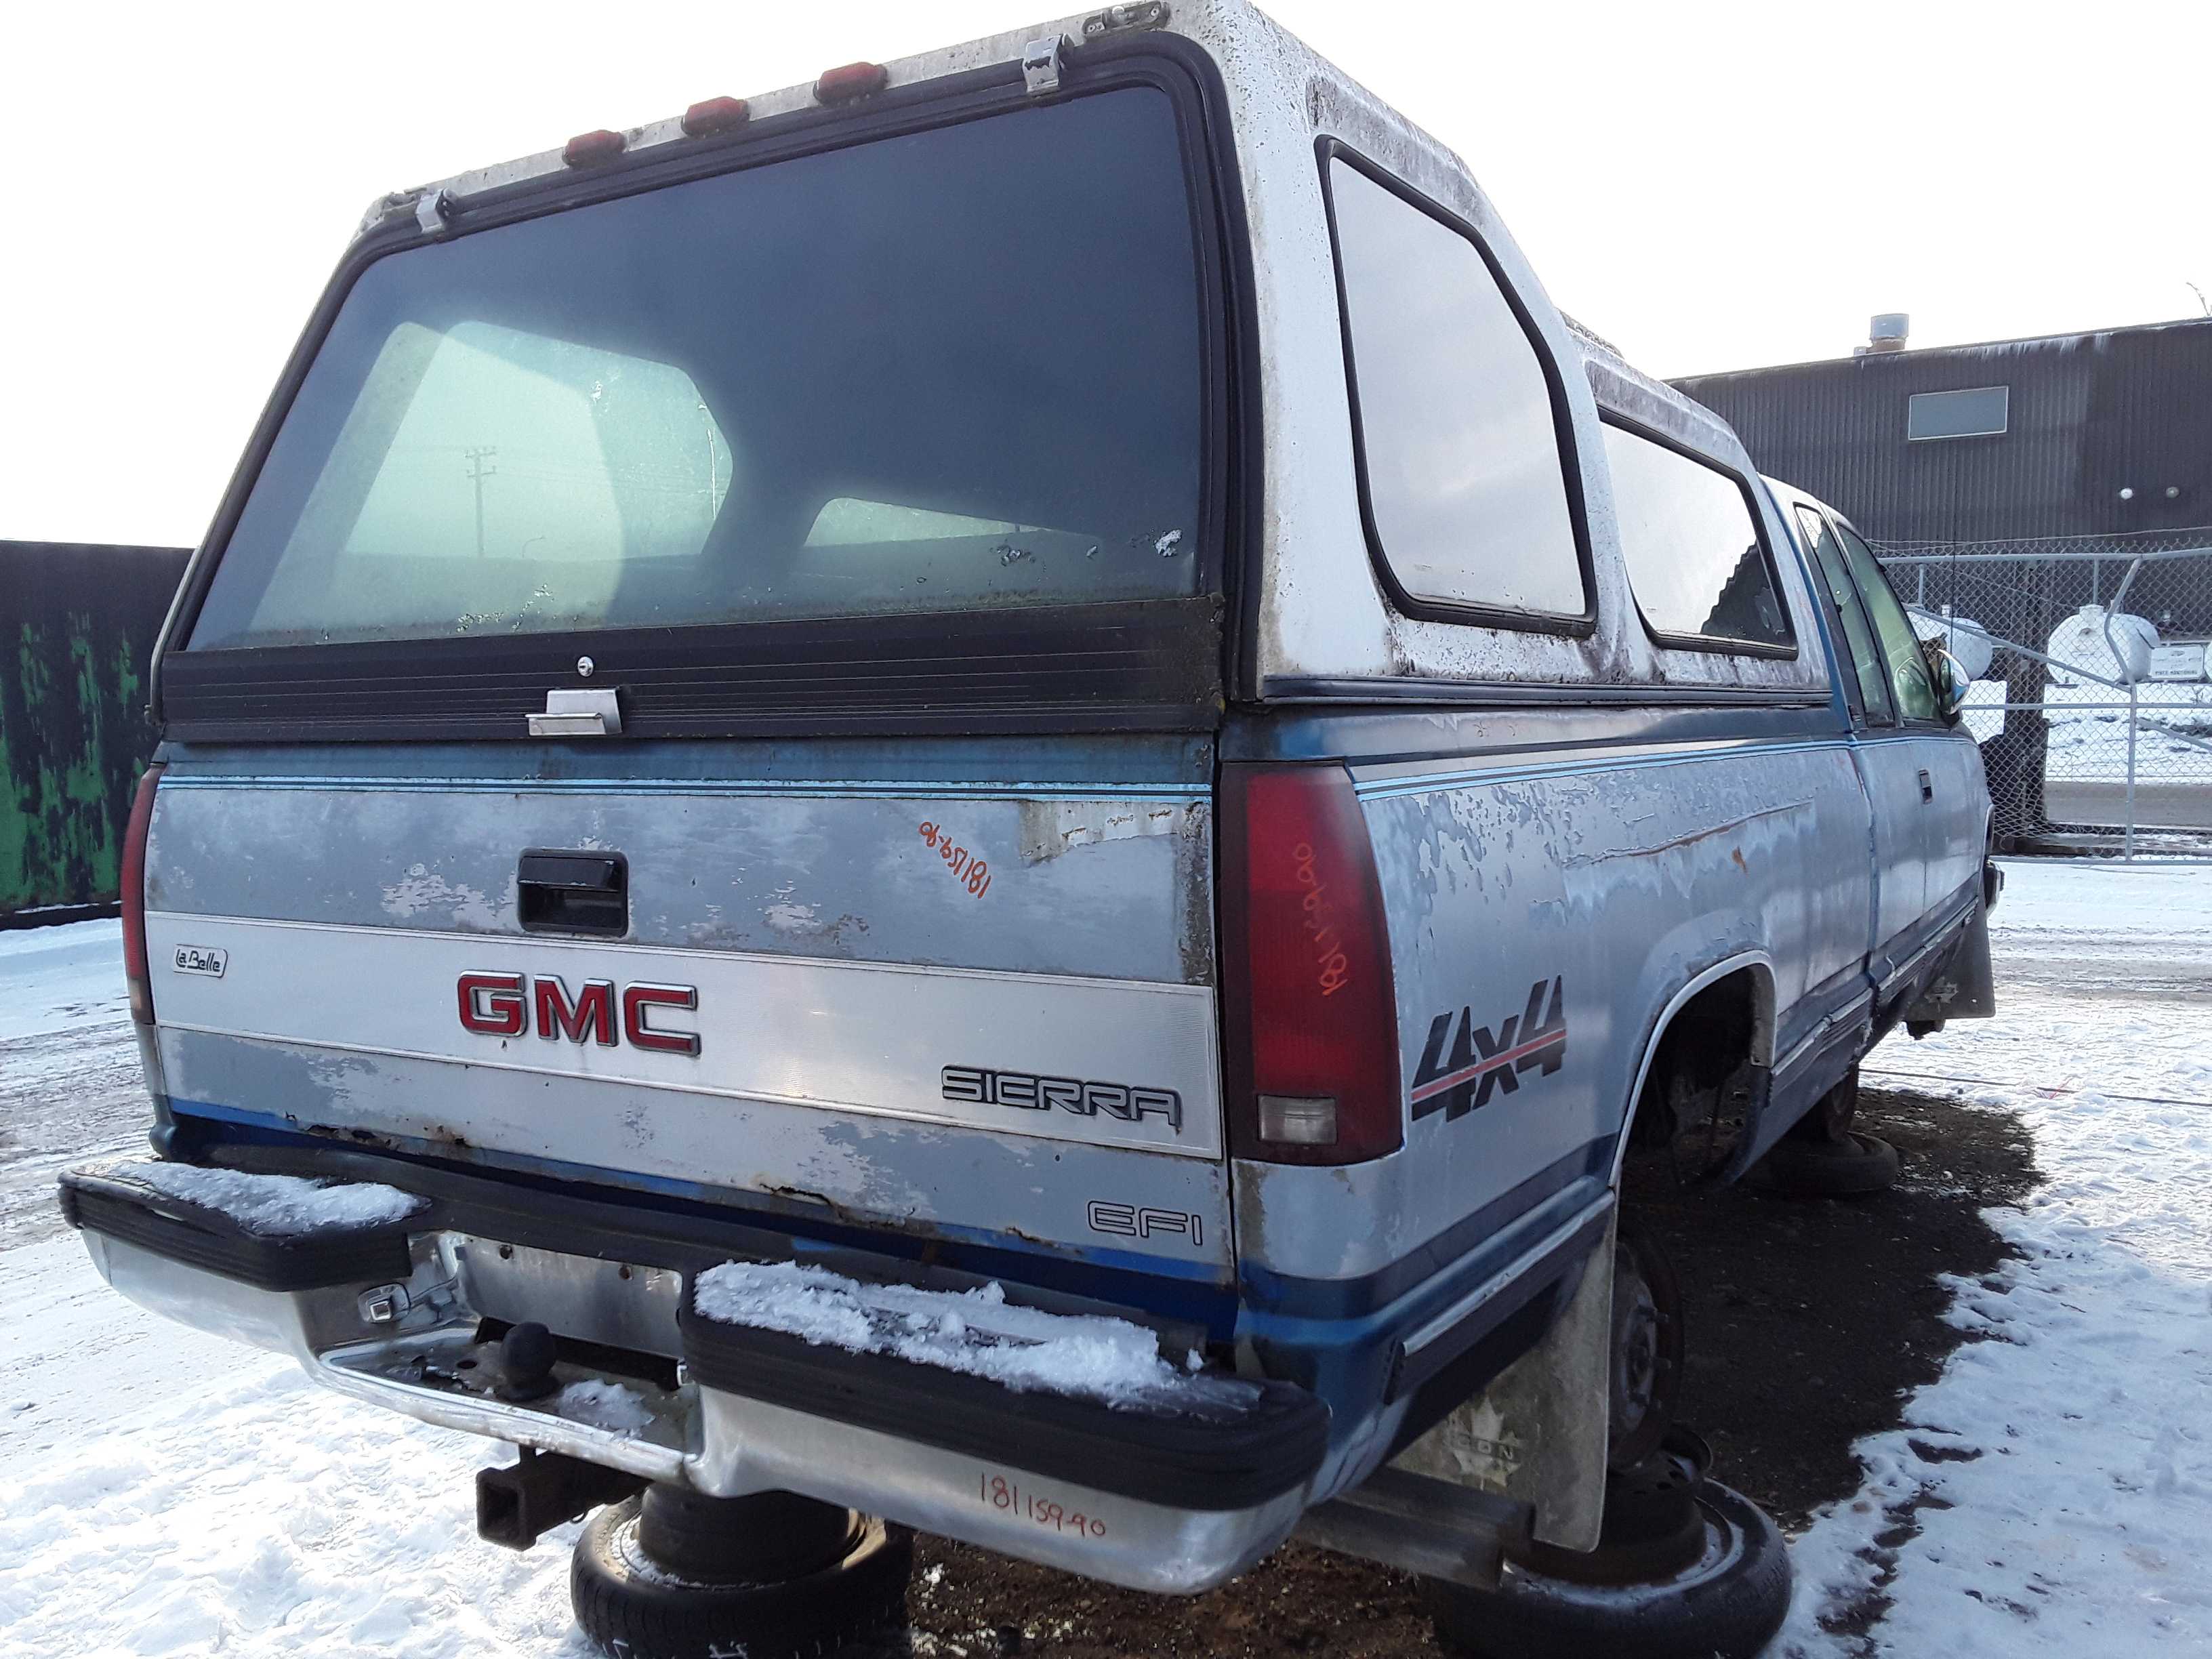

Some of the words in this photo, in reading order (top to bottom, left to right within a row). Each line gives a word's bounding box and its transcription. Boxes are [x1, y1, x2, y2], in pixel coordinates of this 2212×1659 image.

[457, 968, 701, 1059] GMC
[941, 1065, 1183, 1128] SIERRA
[1088, 1200, 1203, 1246] EFI
